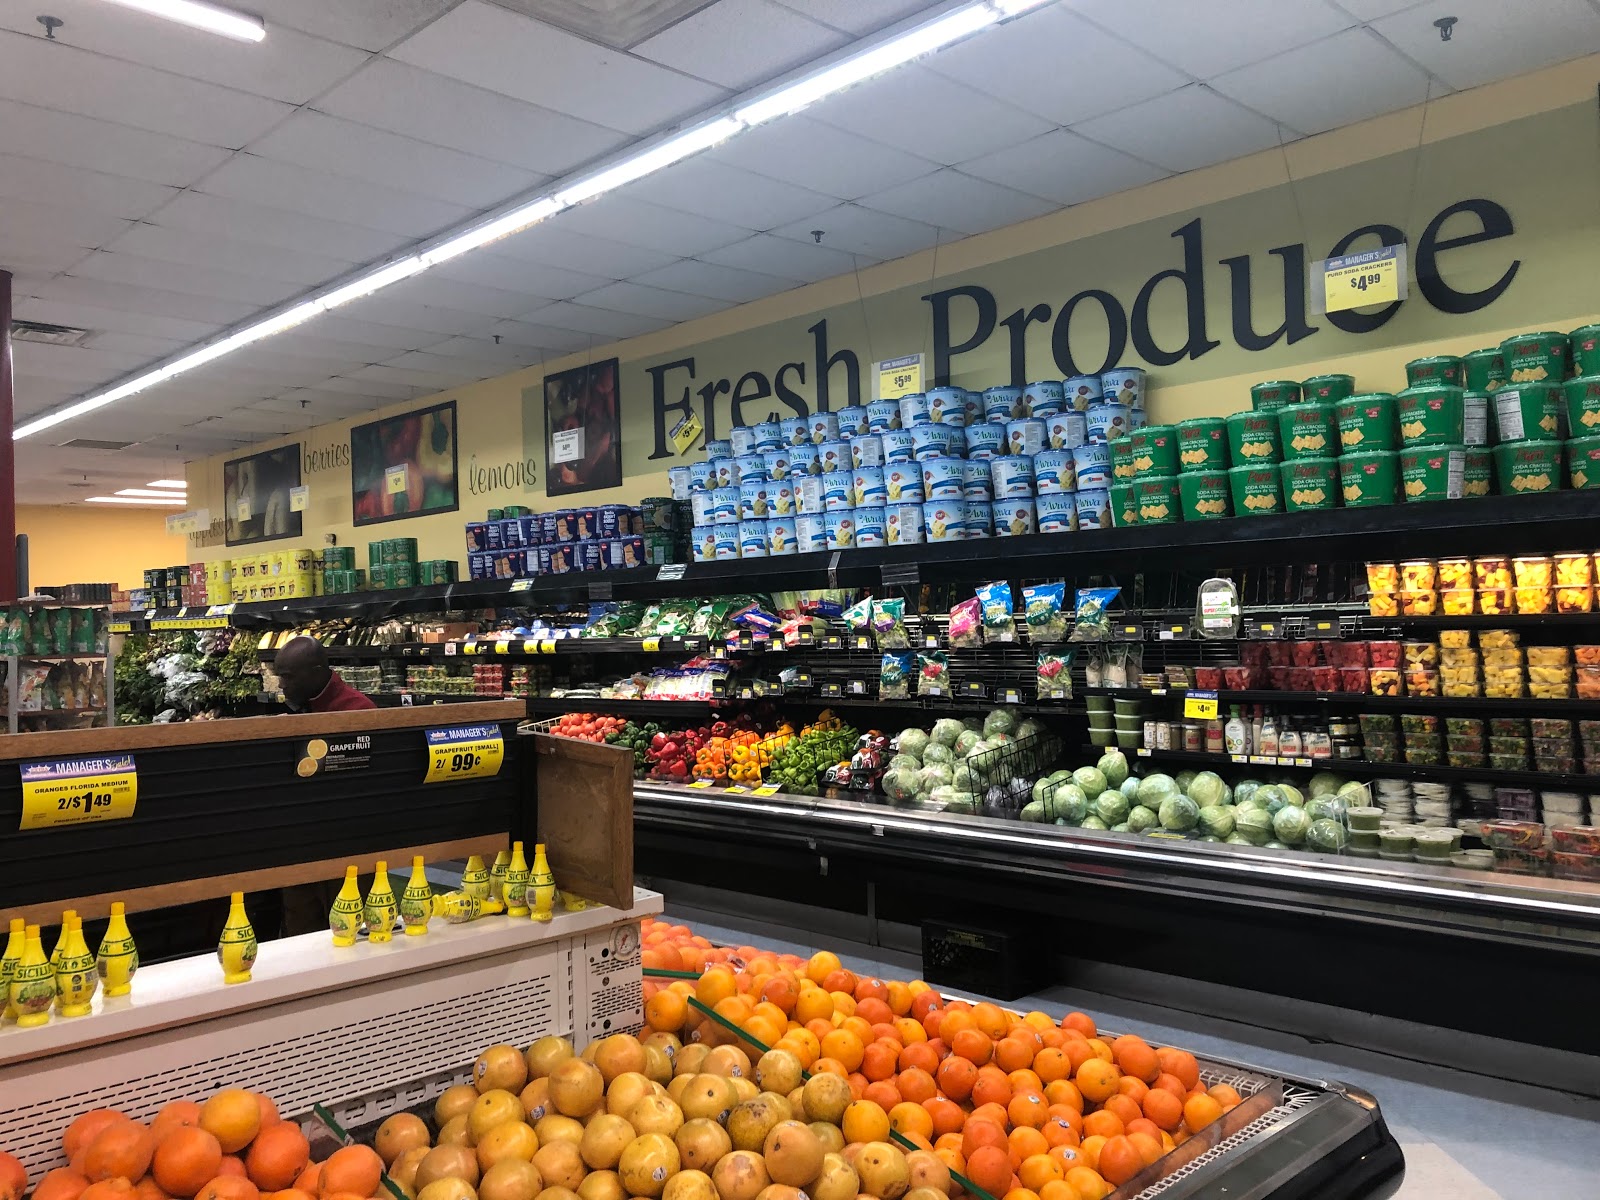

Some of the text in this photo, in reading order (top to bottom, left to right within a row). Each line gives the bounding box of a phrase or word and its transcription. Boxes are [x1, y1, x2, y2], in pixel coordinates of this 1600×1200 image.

[1345, 251, 1379, 265] MANAGER'S
[1361, 261, 1392, 272] CRACKERS
[646, 319, 860, 459] Fresh
[303, 441, 350, 475] berries
[468, 454, 537, 496] lemons
[449, 727, 486, 739] MANAGER'S
[330, 742, 370, 752] GRAPEFRUIT
[435, 746, 473, 754] GRAPEFRUIT
[55, 759, 111, 774] MANAGER'S
